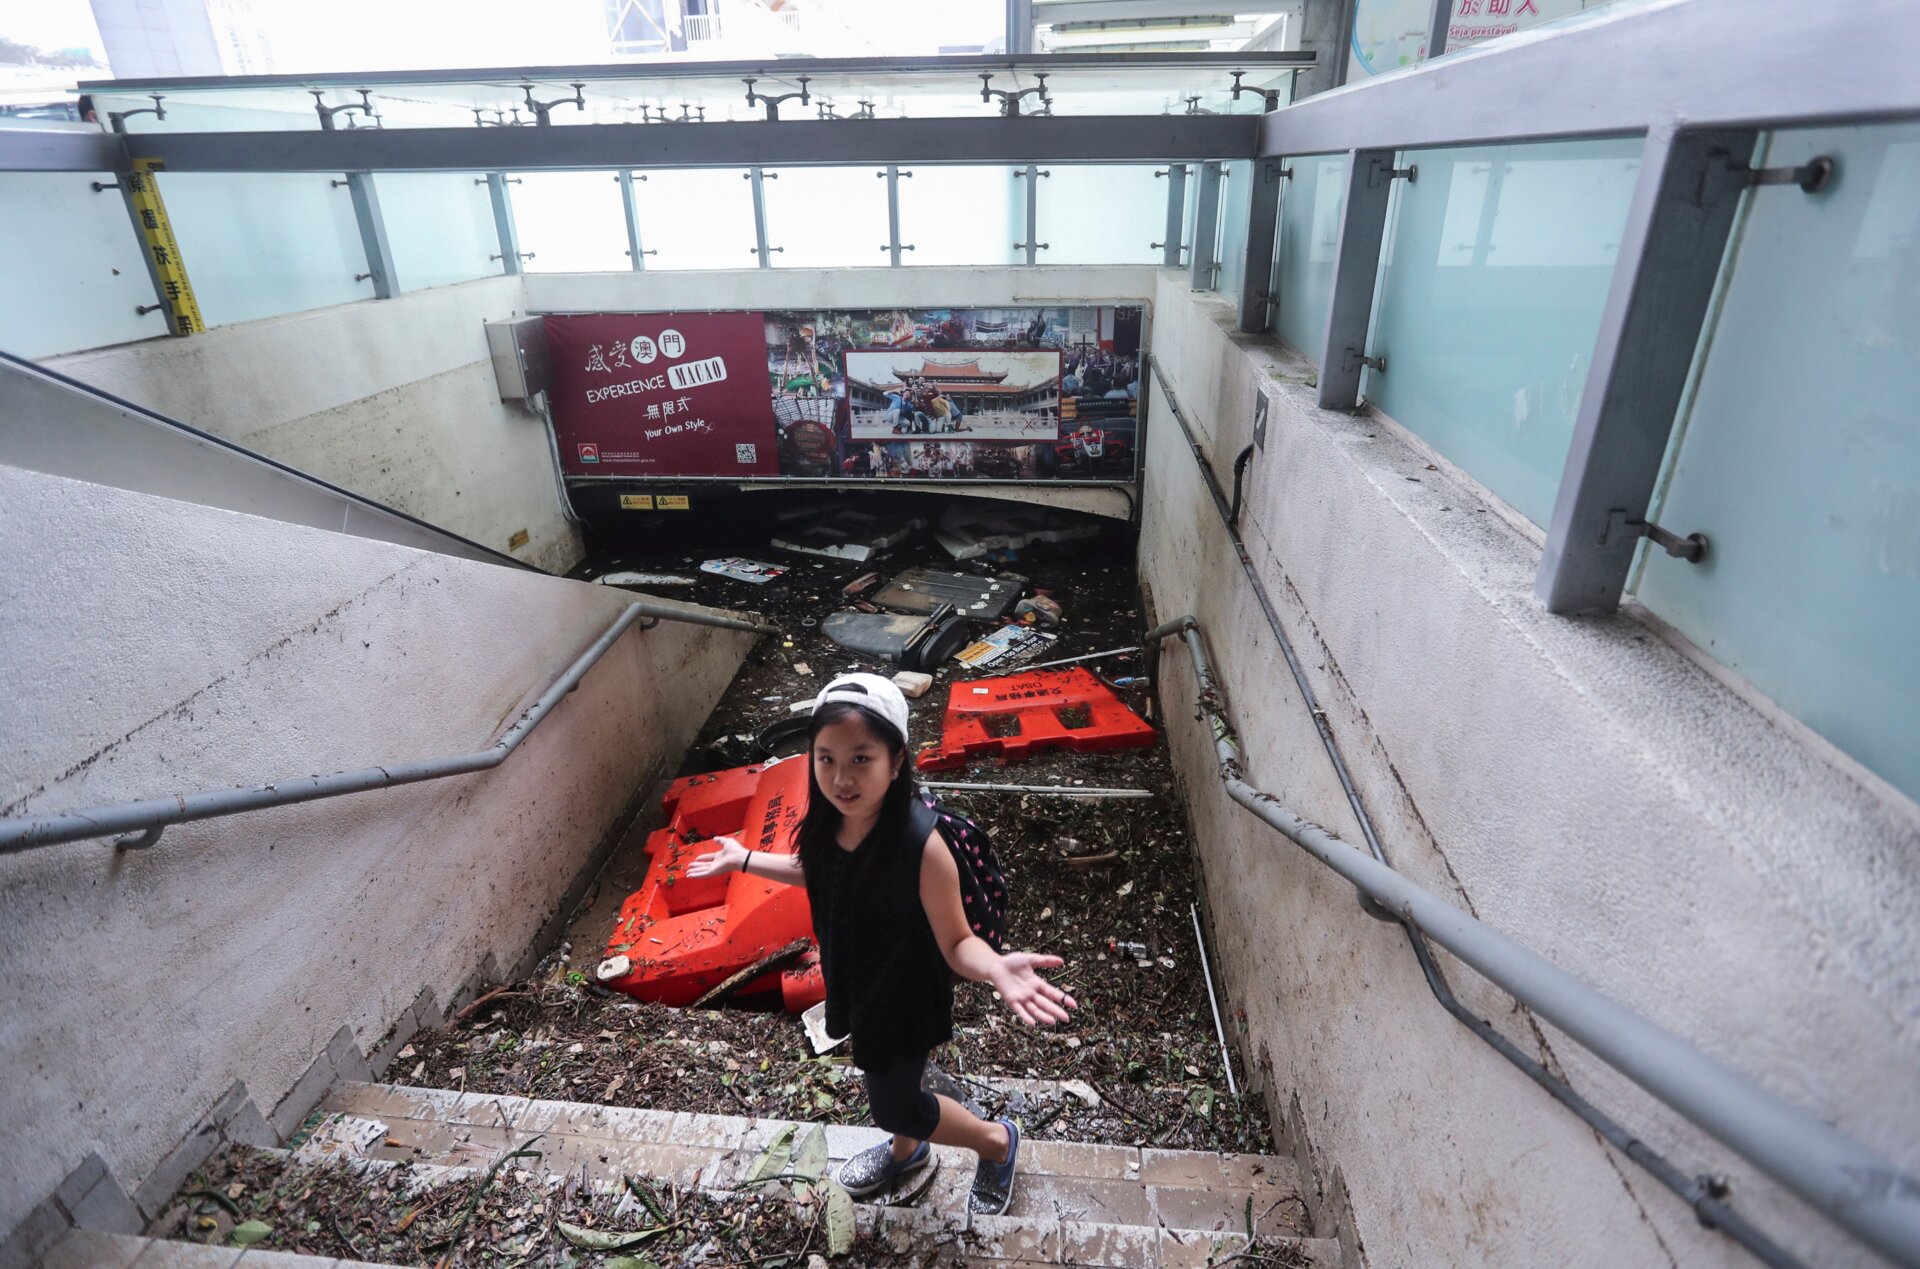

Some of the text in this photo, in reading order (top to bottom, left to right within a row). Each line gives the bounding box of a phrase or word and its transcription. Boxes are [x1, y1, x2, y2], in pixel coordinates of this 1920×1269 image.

[1450, 0, 1539, 16] 於助人
[1449, 24, 1517, 38] Seja prestável
[585, 334, 682, 373] 感受澳門
[586, 360, 722, 403] EXPERIENCE MACAO
[642, 396, 692, 423] 無限式
[644, 418, 705, 441] Your Own Style
[987, 657, 1005, 668] Open
[1002, 651, 1016, 659] Top
[1012, 644, 1027, 653] Bus
[1023, 636, 1038, 645] Tour
[1011, 681, 1043, 691] DSAT
[783, 805, 800, 832] SAT
